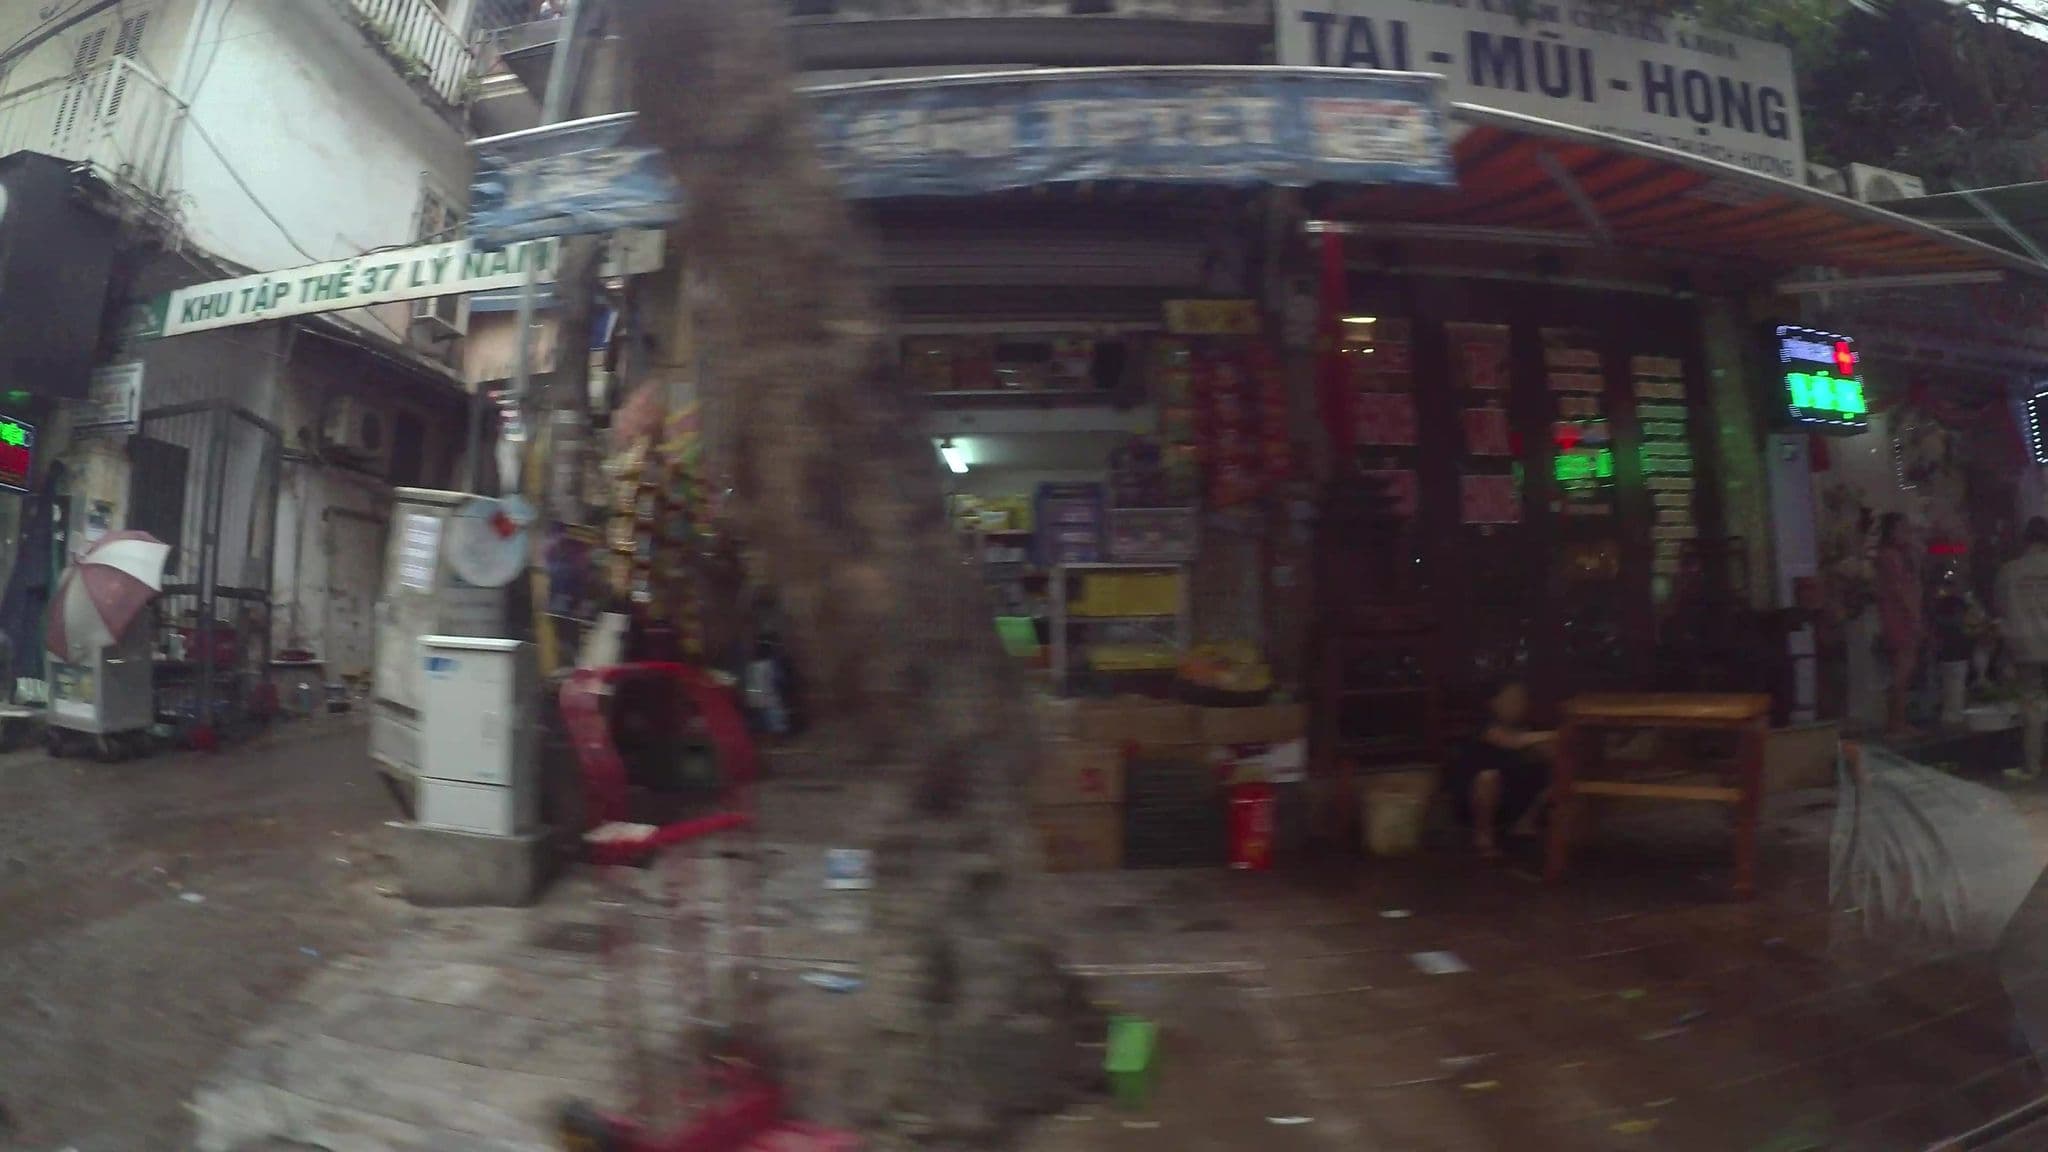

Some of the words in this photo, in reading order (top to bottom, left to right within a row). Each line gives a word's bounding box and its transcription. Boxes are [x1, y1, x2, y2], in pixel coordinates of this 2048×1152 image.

[1302, 11, 1409, 70] TAI
[1466, 30, 1597, 103] MŨI
[1641, 60, 1789, 140] HỌNG
[181, 291, 233, 323] KHU
[239, 277, 291, 316] TẬP
[301, 264, 355, 304] THỂ
[359, 263, 402, 294] 37
[409, 246, 455, 287] LÝ
